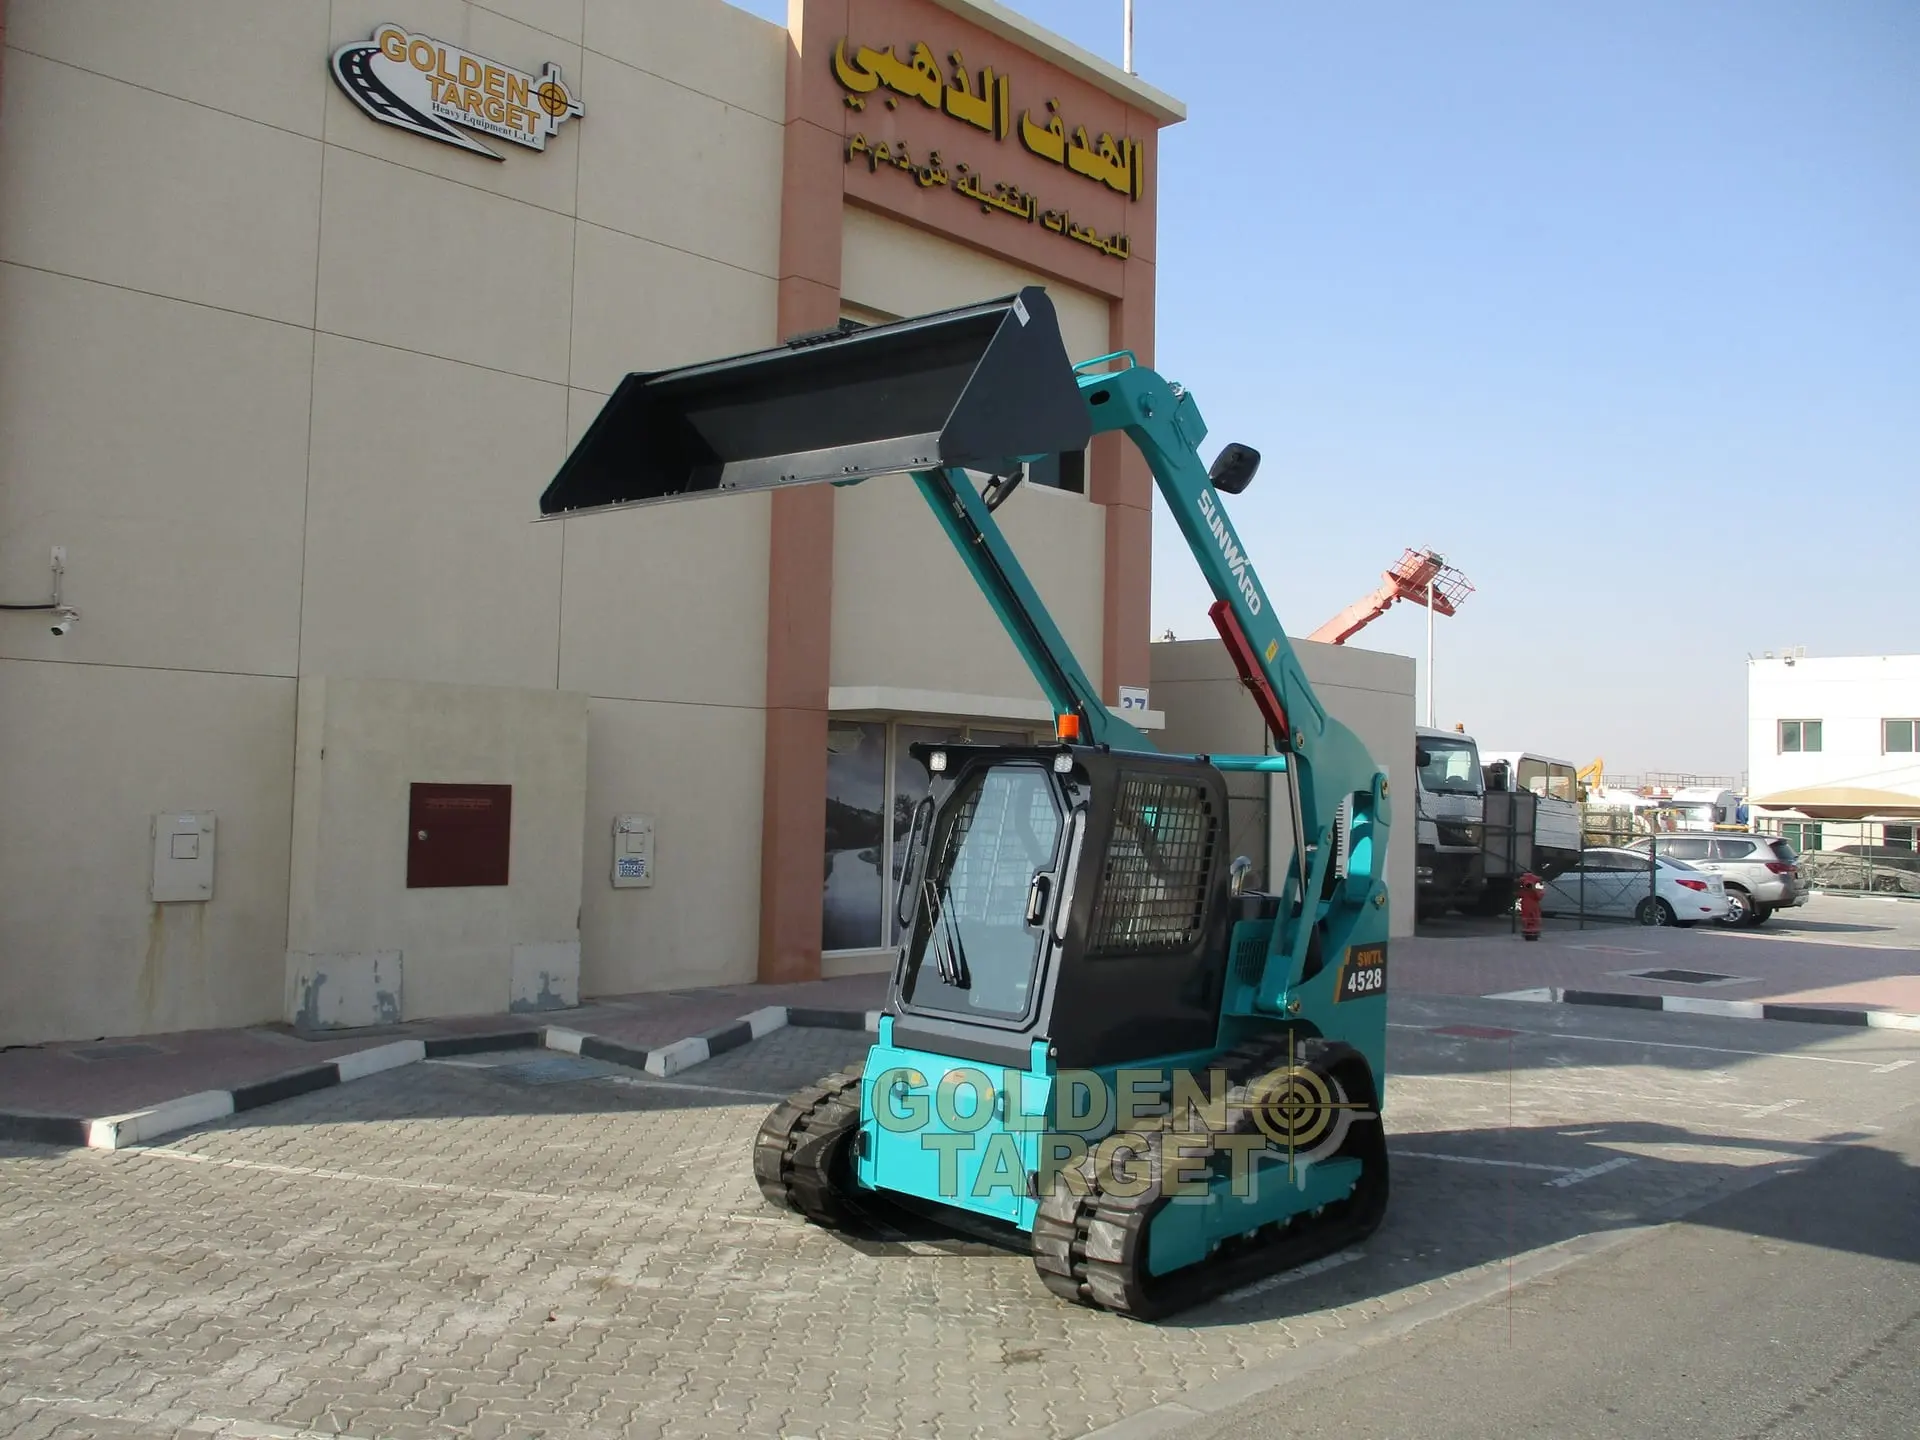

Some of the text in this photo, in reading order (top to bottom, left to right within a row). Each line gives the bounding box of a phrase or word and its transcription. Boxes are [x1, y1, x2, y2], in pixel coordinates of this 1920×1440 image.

[379, 29, 529, 108] GOLDEN
[426, 74, 541, 135] TARGET
[432, 102, 460, 120] Heavy
[463, 112, 512, 138] Equipment
[832, 36, 1144, 202] الهدف الذهبي
[956, 163, 1038, 223] الثقيلة
[1041, 208, 1131, 260] للمعدات
[1197, 488, 1261, 616] SUNWARD
[1347, 968, 1382, 993] 4528
